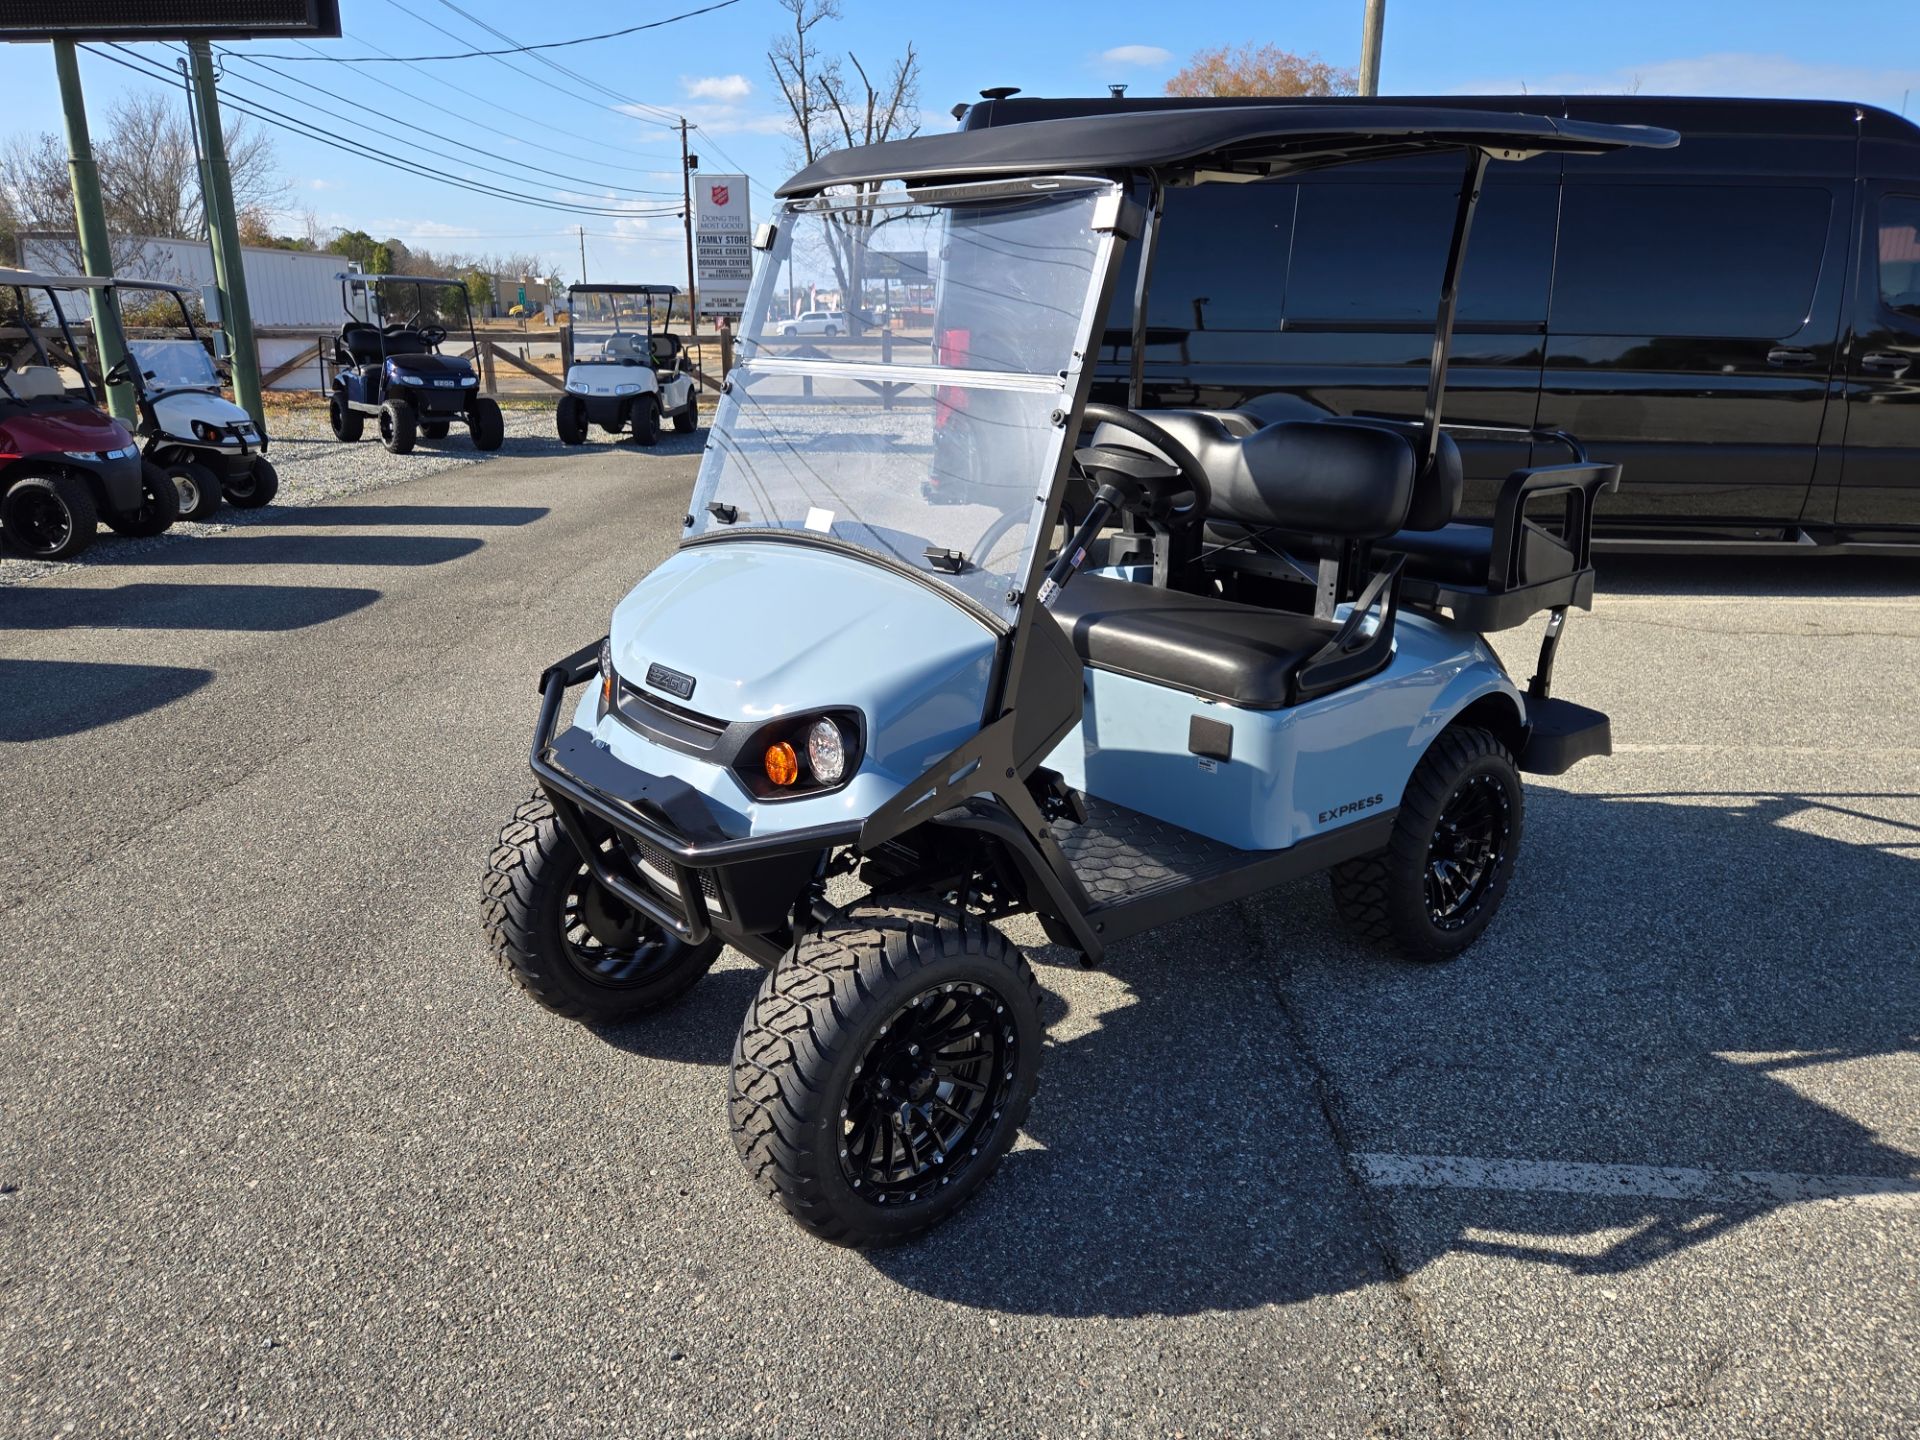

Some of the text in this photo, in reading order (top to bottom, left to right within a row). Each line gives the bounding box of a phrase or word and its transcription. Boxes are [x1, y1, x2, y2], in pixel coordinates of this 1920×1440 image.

[698, 235, 748, 245] FAMILY STORE
[698, 258, 750, 267] DONATION CENTER
[1318, 793, 1384, 825] EXPRESS
